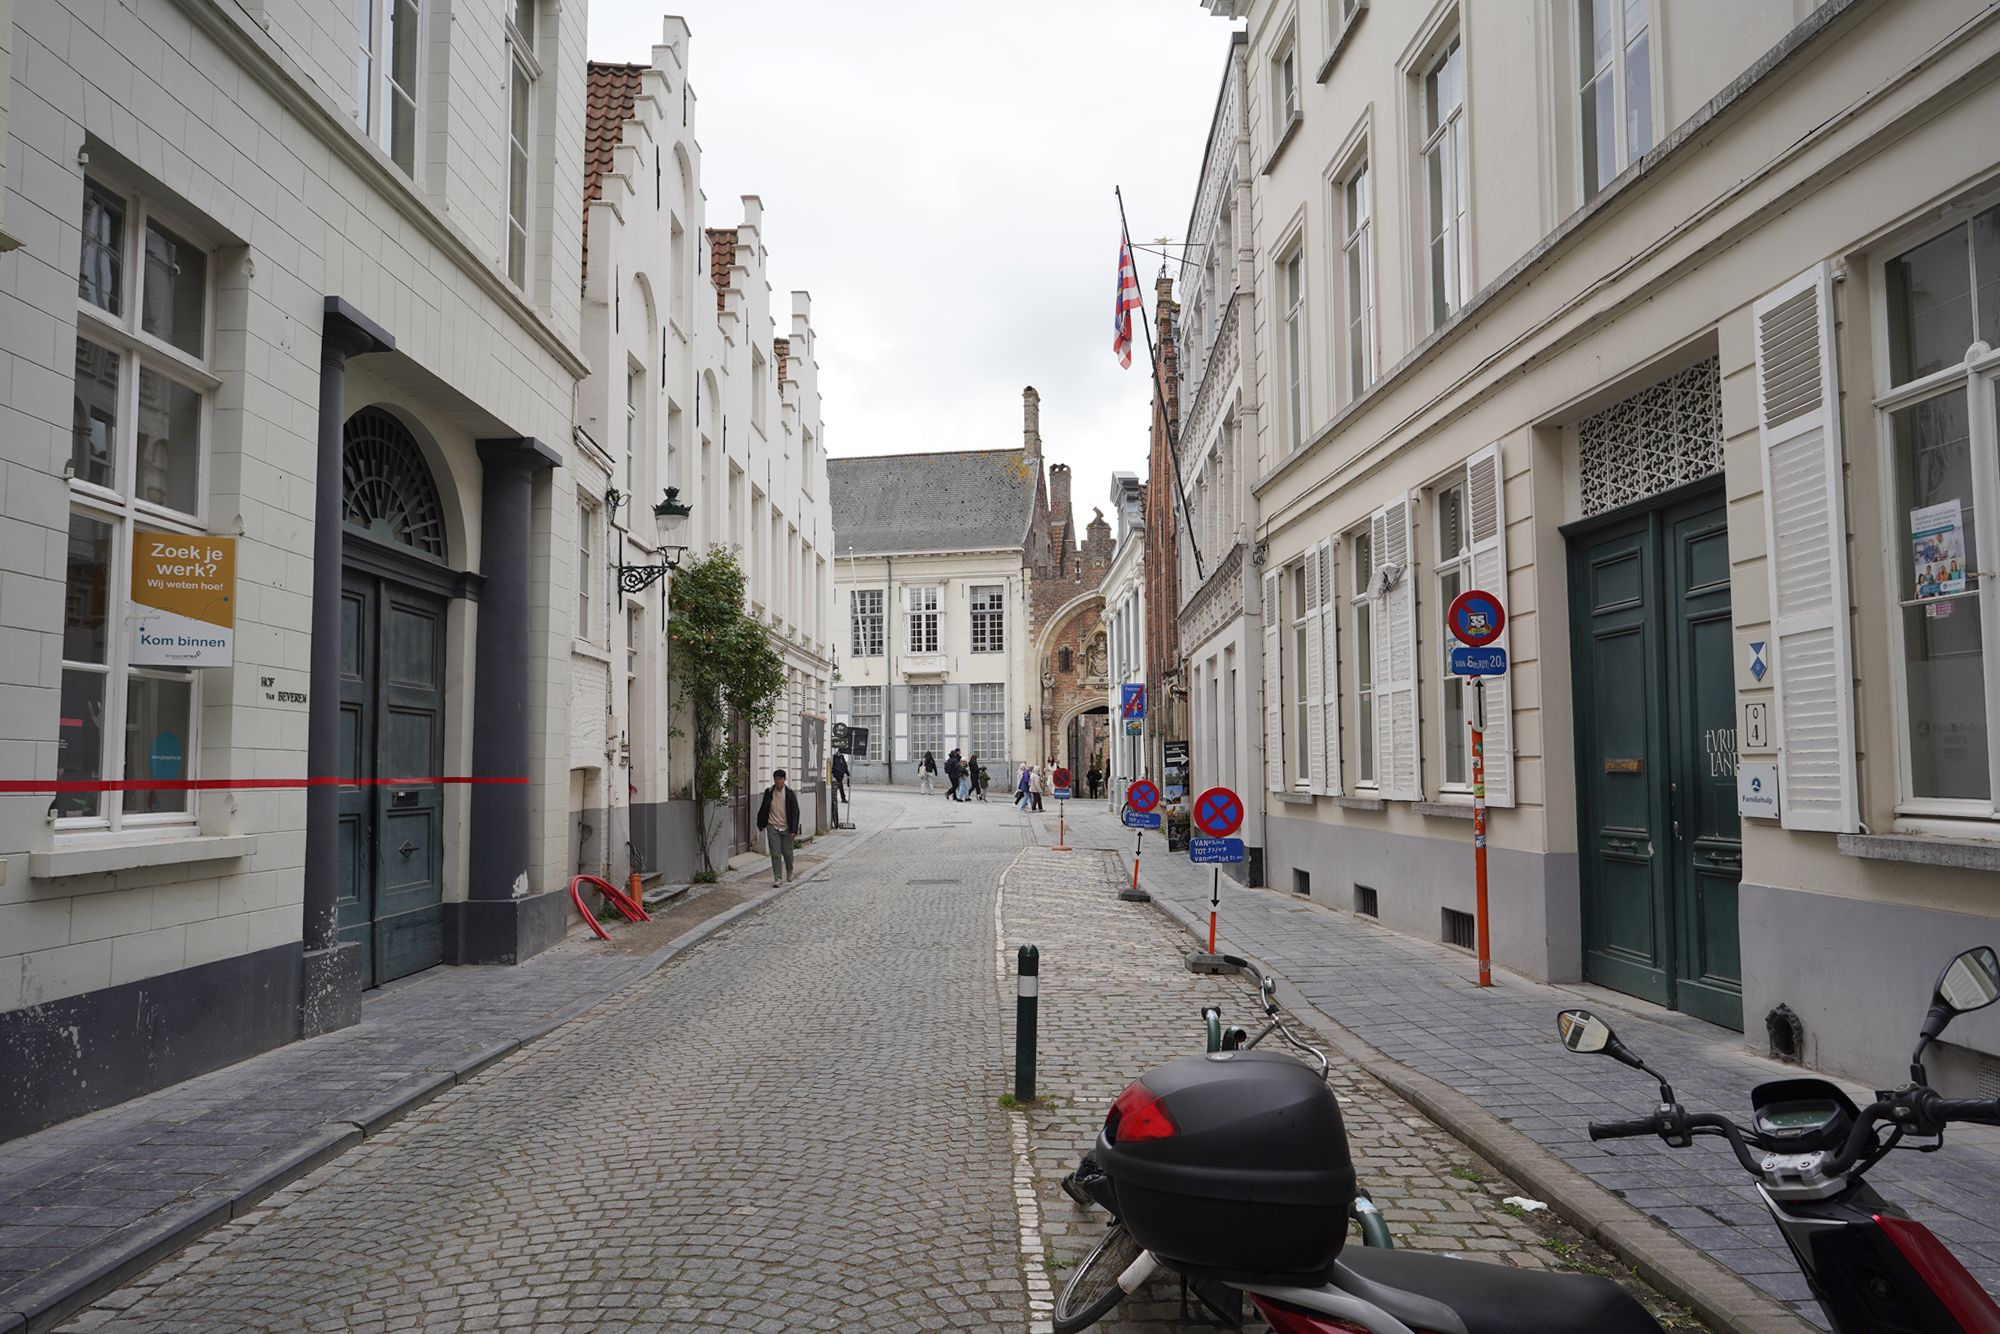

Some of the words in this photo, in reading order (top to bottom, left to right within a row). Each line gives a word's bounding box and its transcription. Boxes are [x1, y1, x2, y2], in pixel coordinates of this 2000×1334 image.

[151, 543, 200, 559] Zoek
[204, 546, 223, 563] je
[157, 563, 217, 577] werk?
[147, 579, 164, 589] Wij
[166, 581, 199, 590] weten
[201, 579, 224, 591] hoe!
[141, 635, 174, 646] Kom
[178, 636, 226, 648] binnen
[261, 676, 275, 687] HOF
[278, 691, 307, 703] BEVEREN
[1195, 839, 1209, 847] VAN
